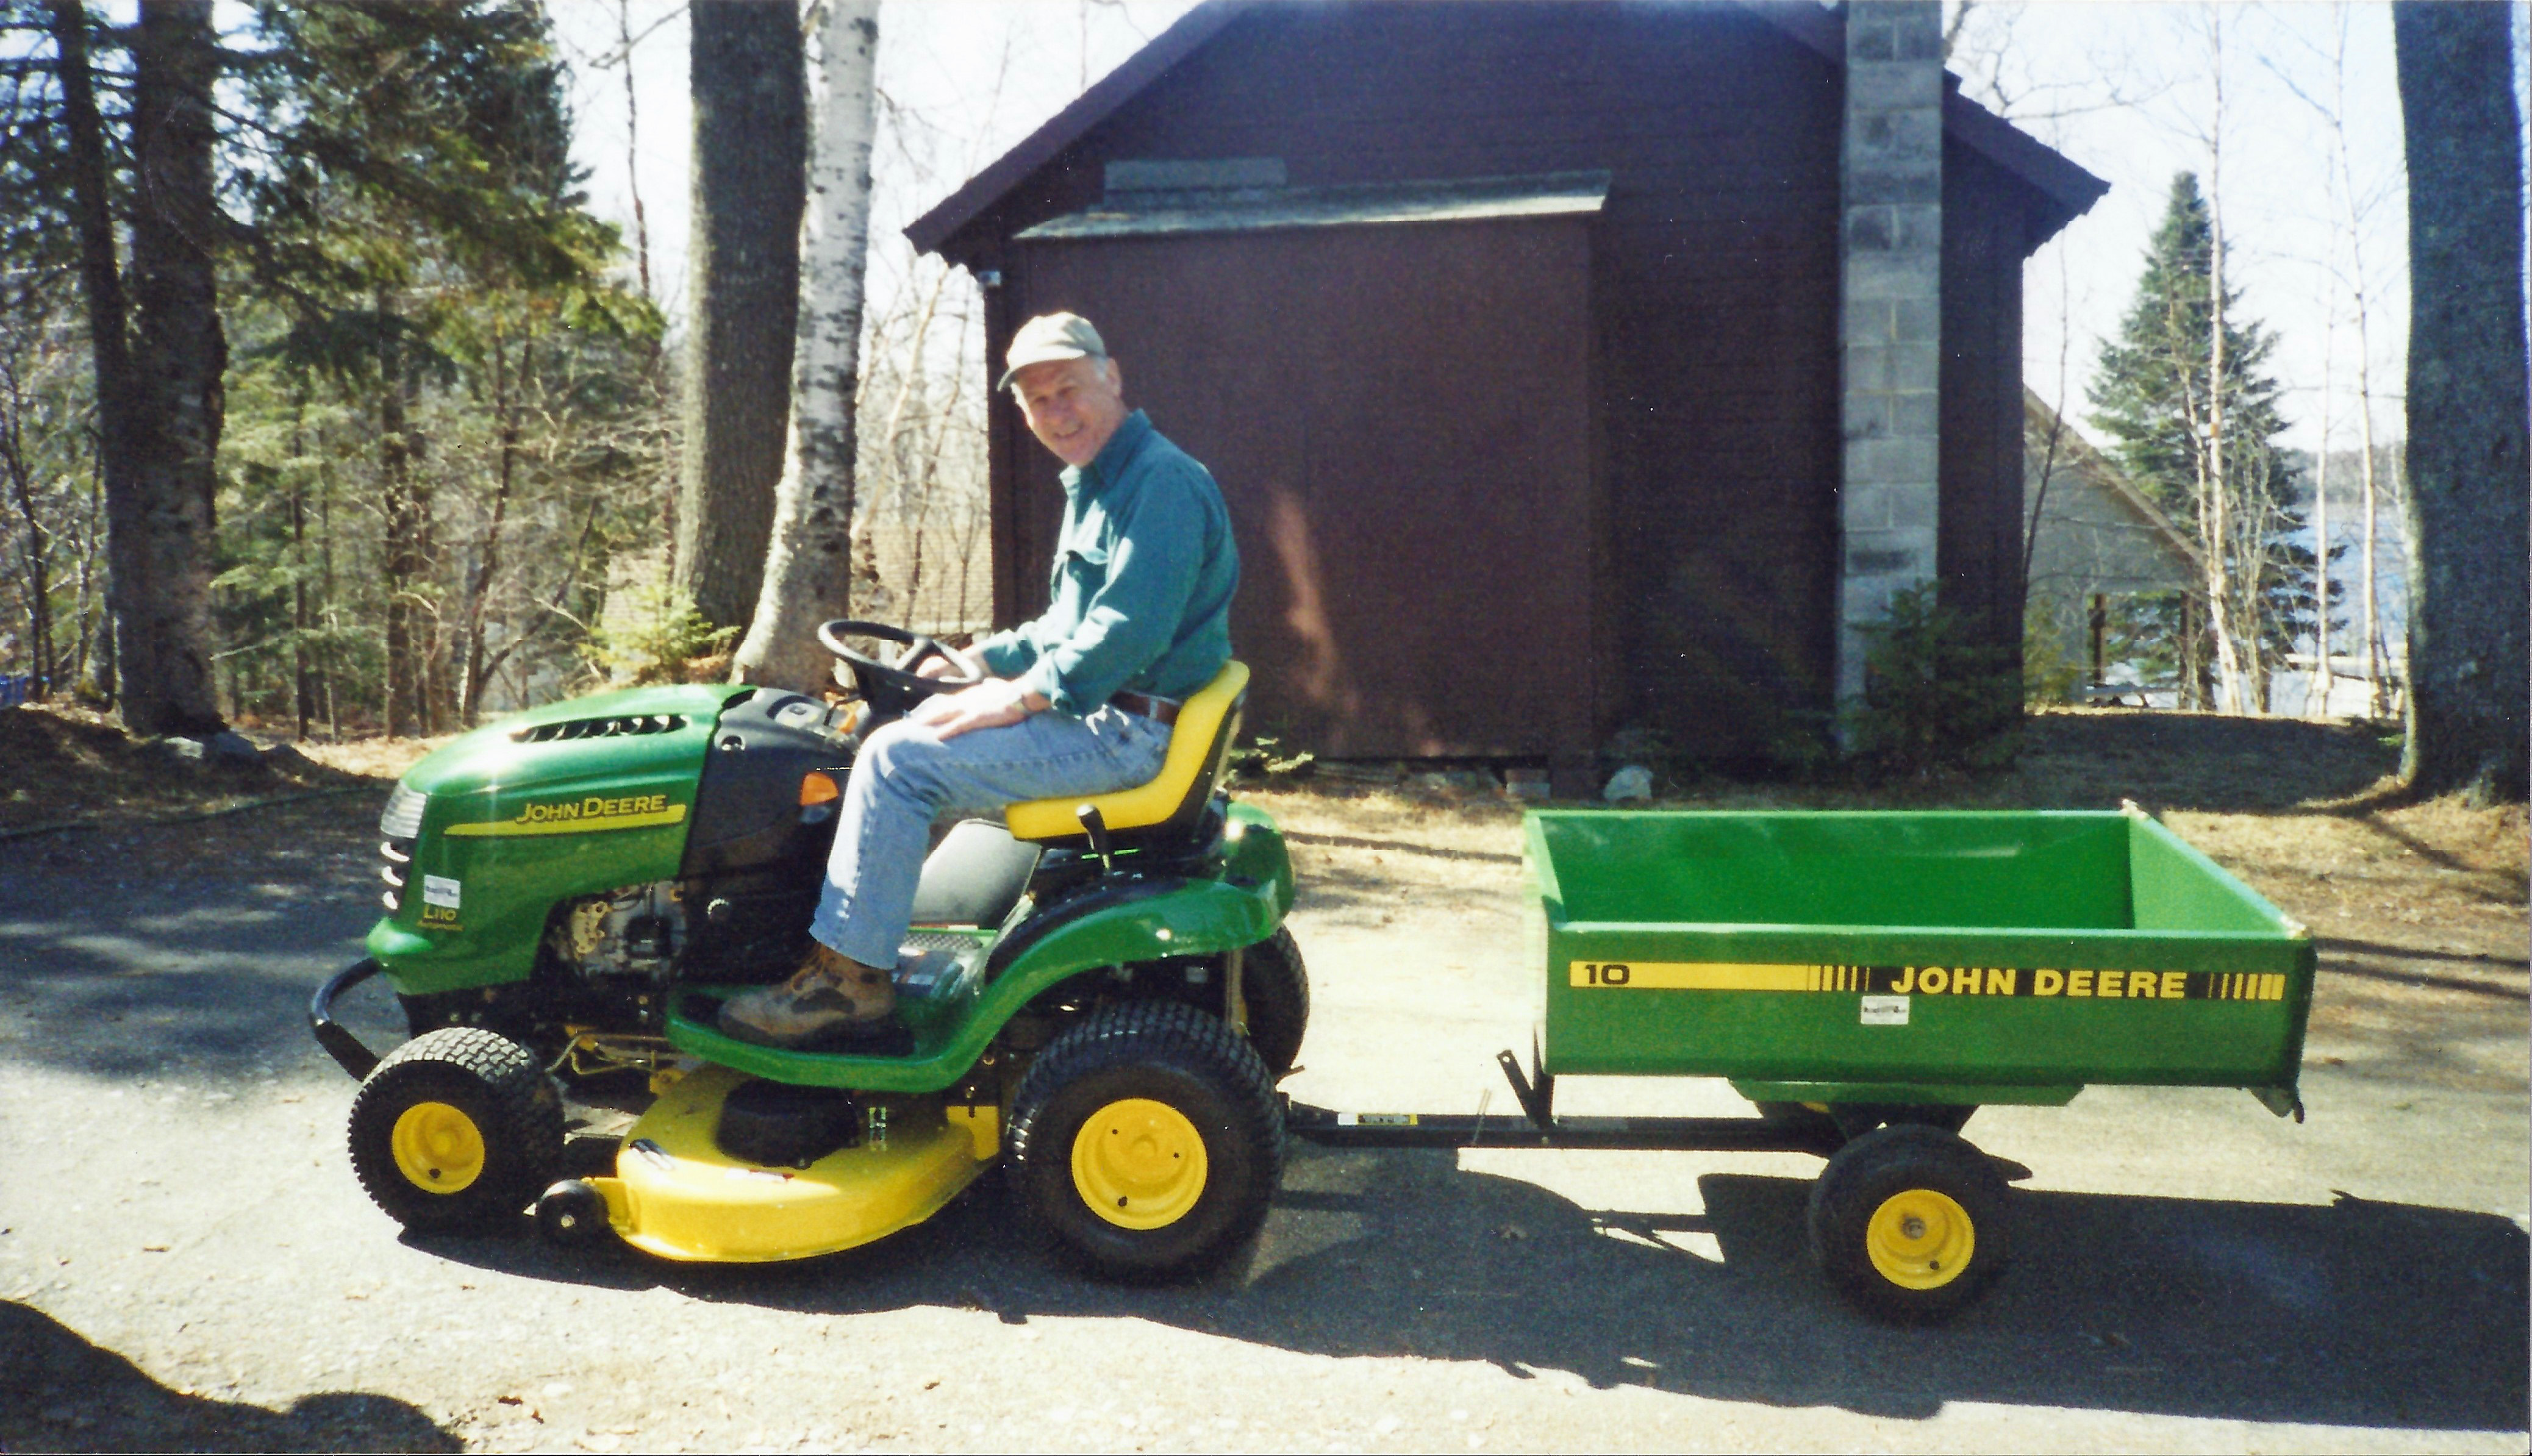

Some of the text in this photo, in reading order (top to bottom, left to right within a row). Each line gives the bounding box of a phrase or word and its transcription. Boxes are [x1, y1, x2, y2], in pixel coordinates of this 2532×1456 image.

[516, 794, 667, 823] JOHN DEERE
[1585, 964, 1629, 985] 10
[1891, 966, 2188, 999] JOHN DEERE
